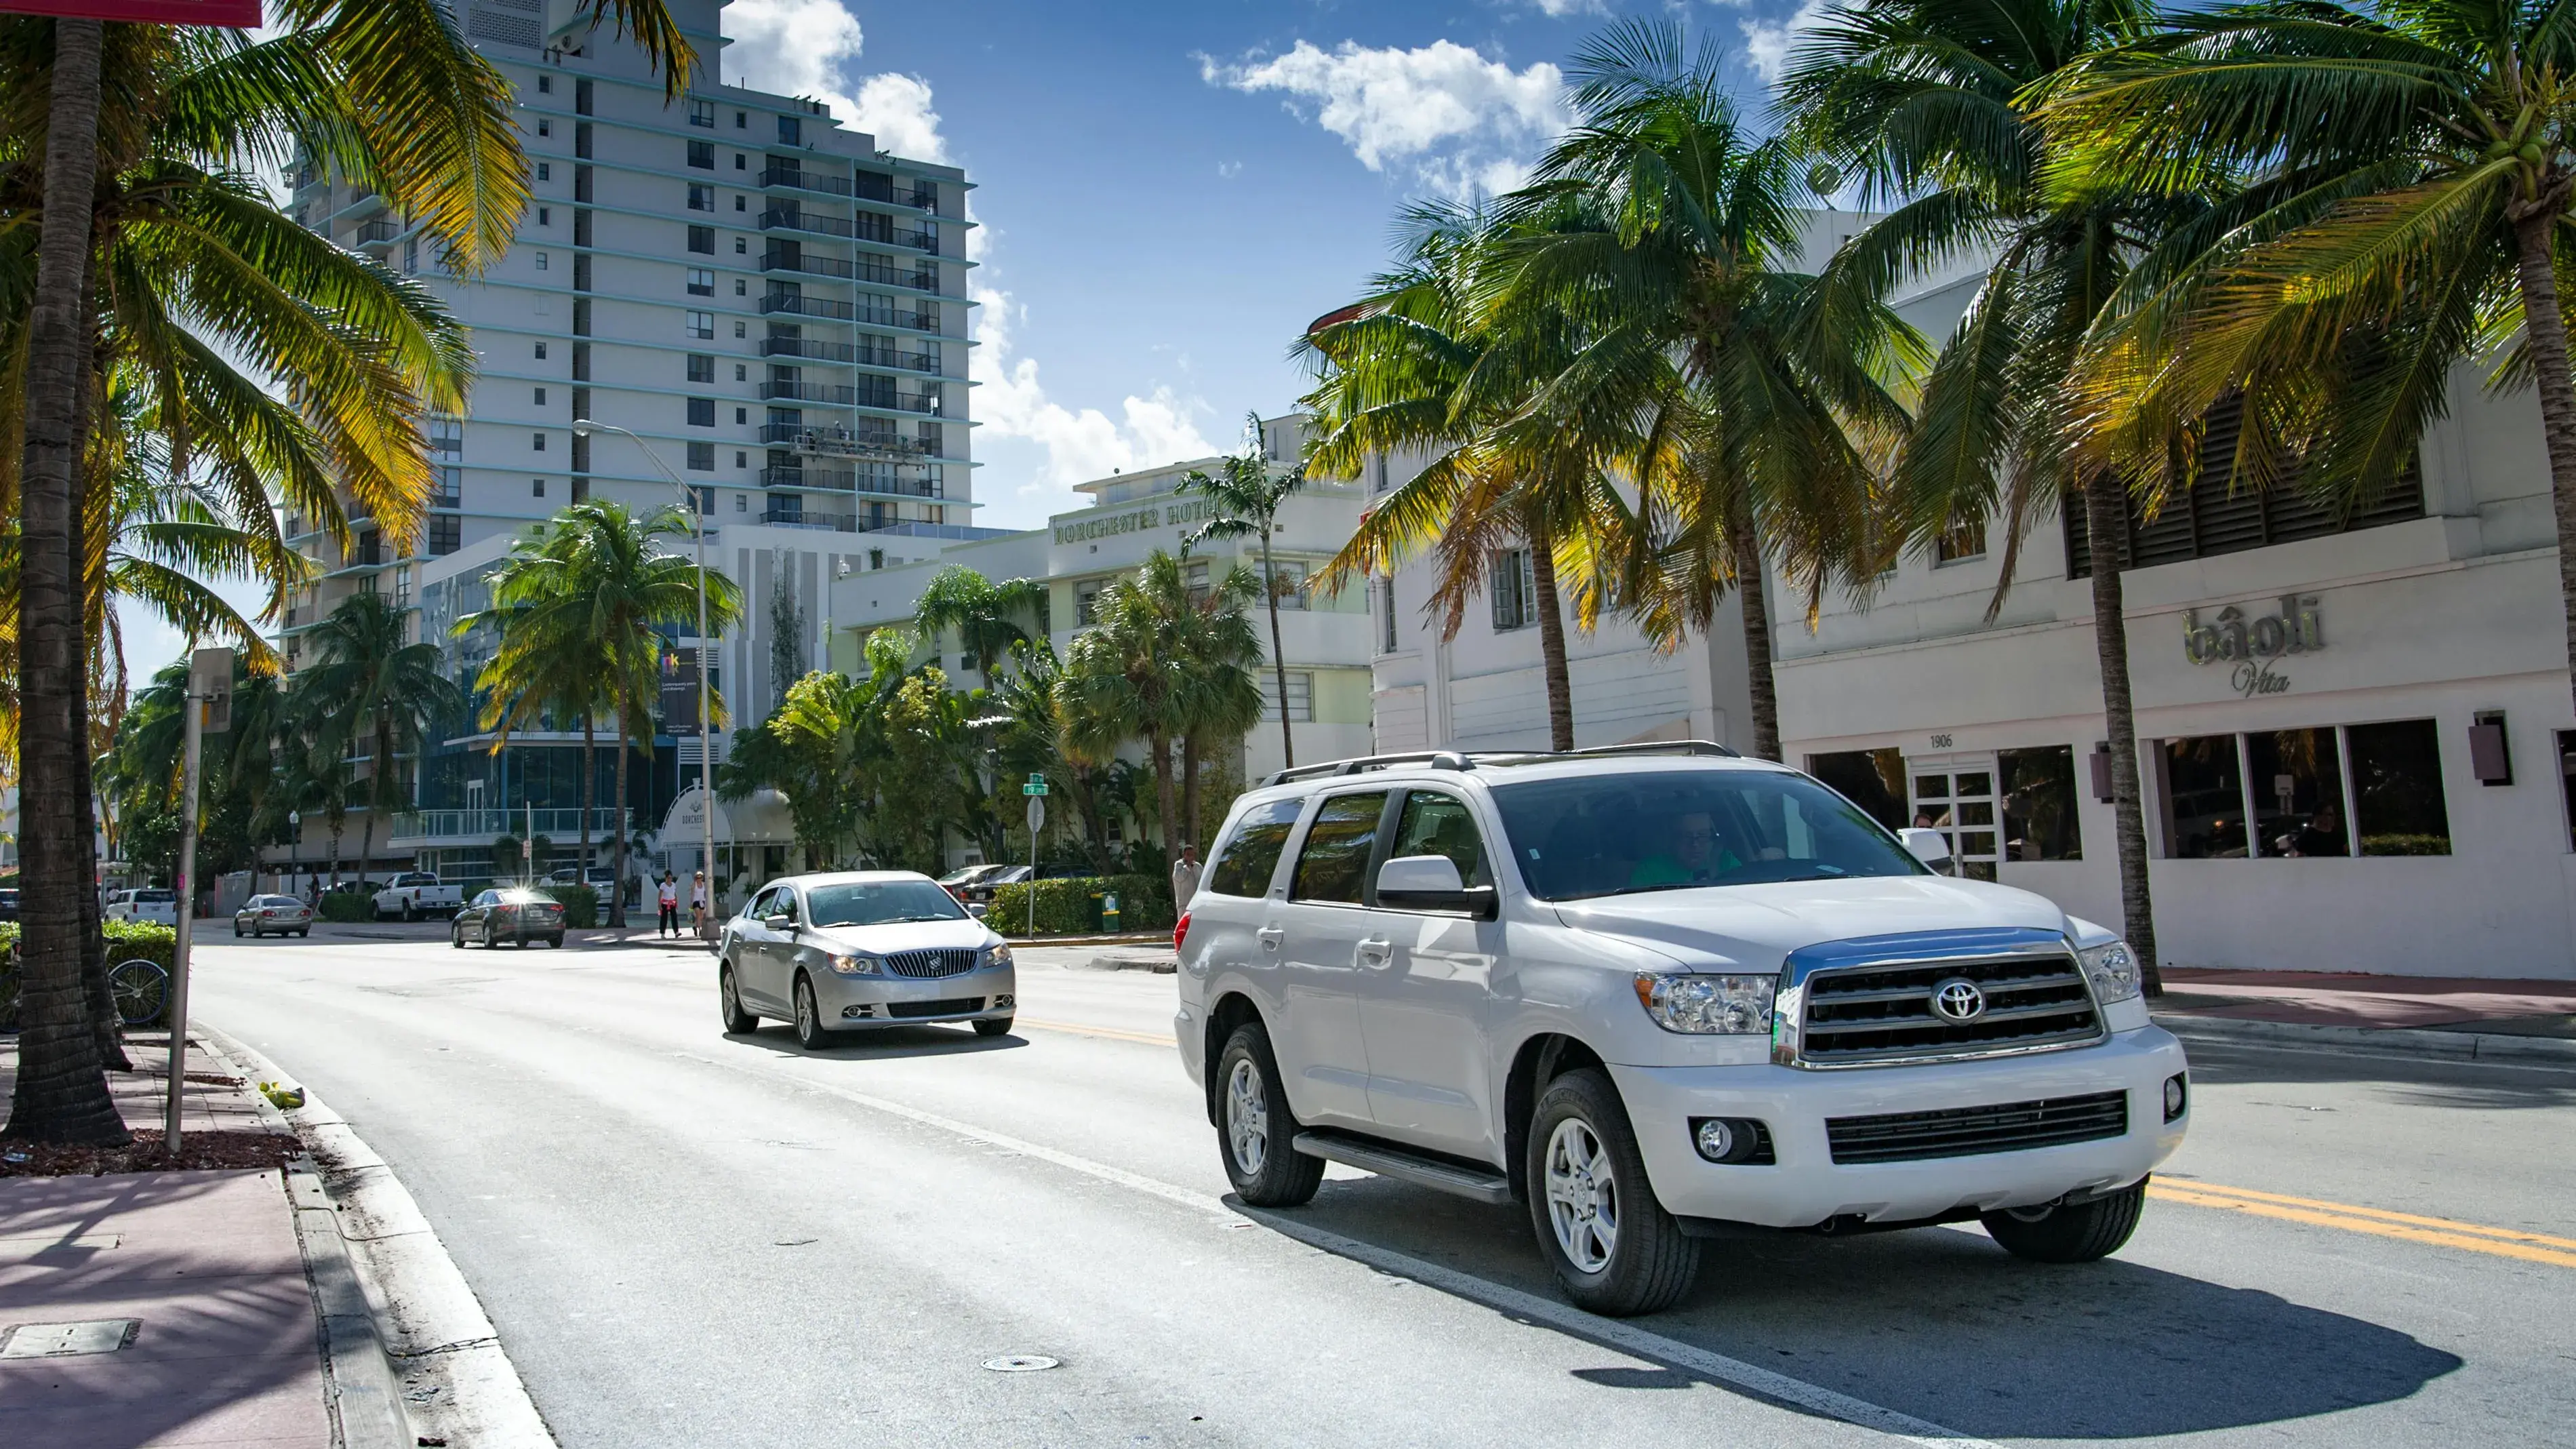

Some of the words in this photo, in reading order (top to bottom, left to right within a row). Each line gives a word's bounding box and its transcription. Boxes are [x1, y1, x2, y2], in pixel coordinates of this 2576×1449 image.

[1054, 509, 1160, 545] DORCHESTER
[1167, 497, 1223, 525] HOTEL
[2232, 654, 2291, 698] Vita
[1931, 734, 1952, 749] 1906
